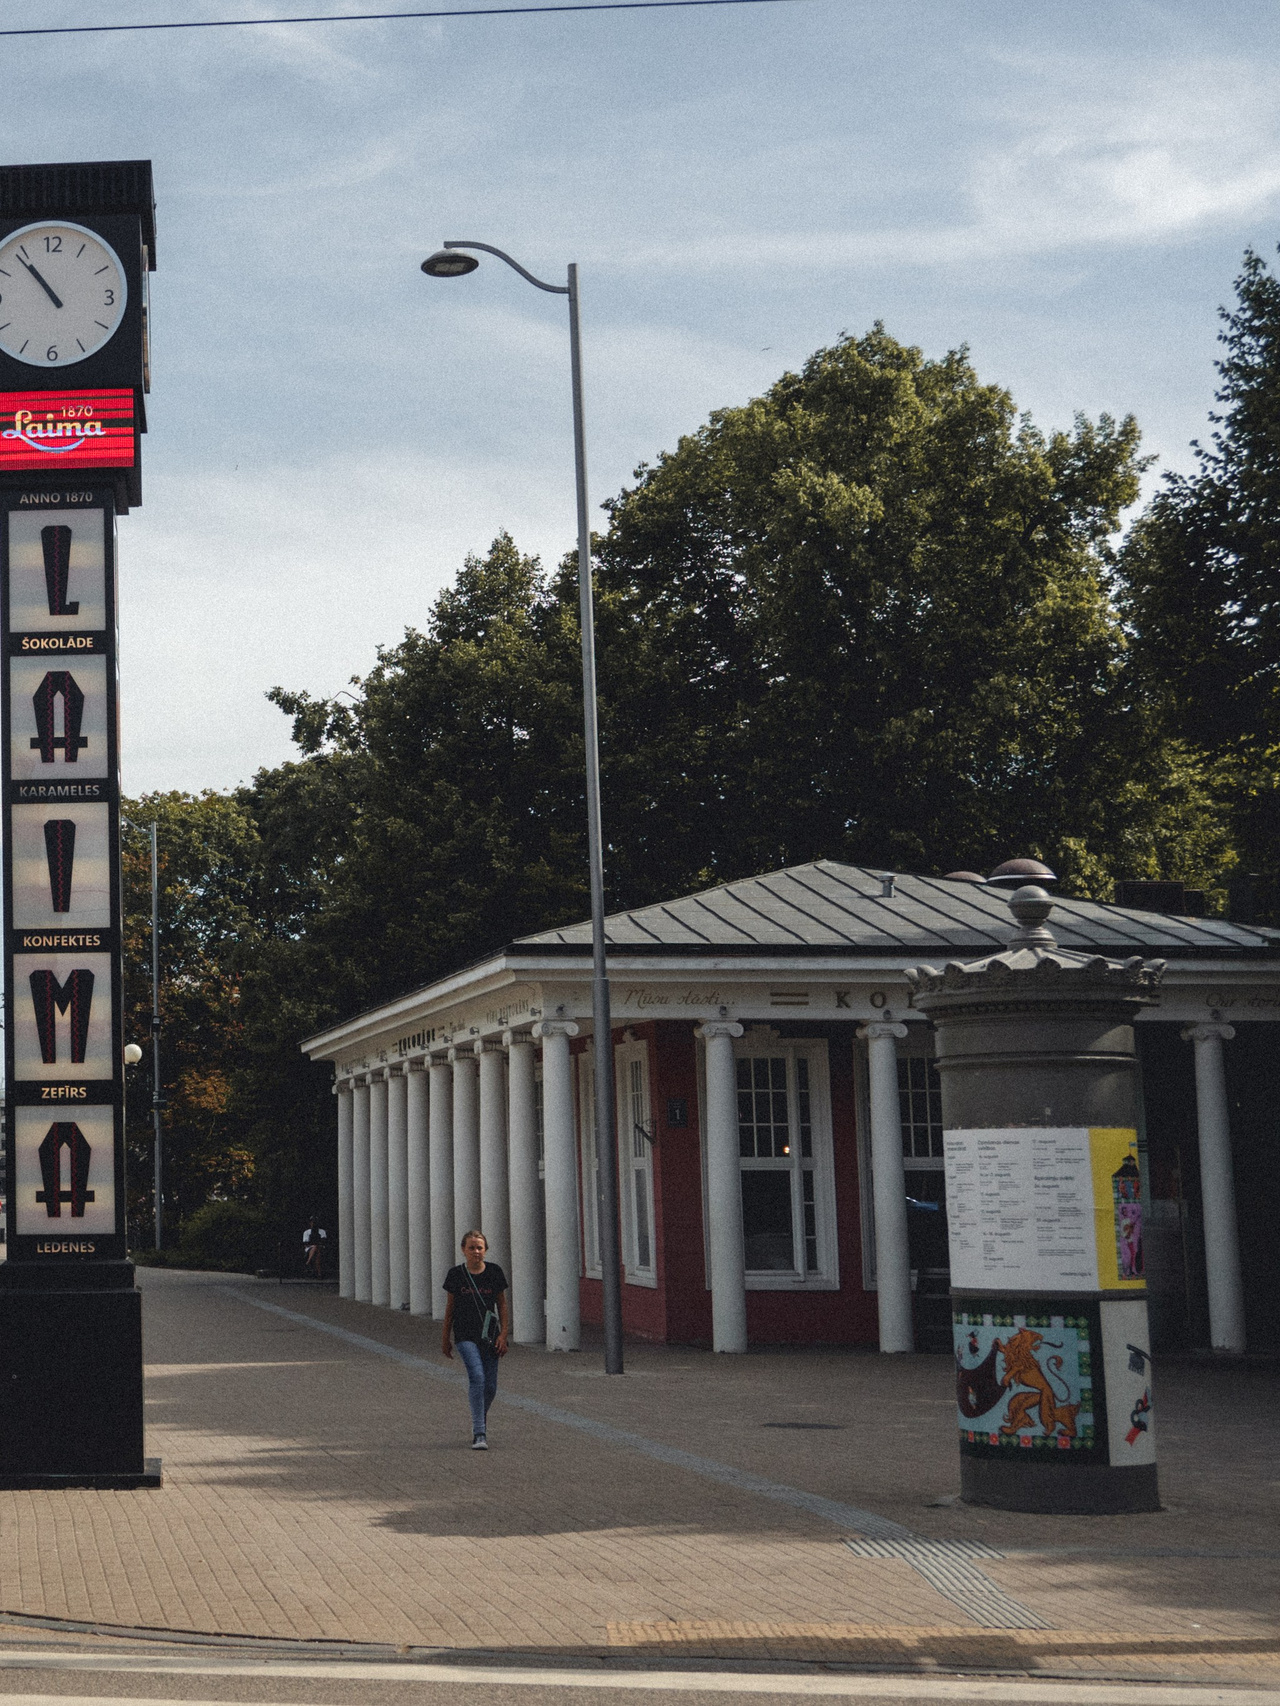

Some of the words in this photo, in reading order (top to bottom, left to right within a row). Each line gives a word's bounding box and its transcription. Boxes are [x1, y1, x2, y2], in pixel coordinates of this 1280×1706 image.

[43, 235, 63, 254] 12
[104, 290, 115, 307] 3
[46, 345, 58, 362] 6
[61, 405, 93, 417] 1870
[2, 409, 106, 453] Laima
[20, 493, 61, 504] ANNO
[65, 492, 93, 503] 1870
[22, 636, 94, 650] ŠOKOLĀDE
[20, 785, 100, 797] KARAMELES
[23, 935, 101, 948] KONFEKTES
[624, 988, 668, 1009] Mūsu
[41, 1085, 87, 1099] ZEFĪRS
[675, 1109, 681, 1120] 1
[36, 1241, 96, 1254] LEDENES
